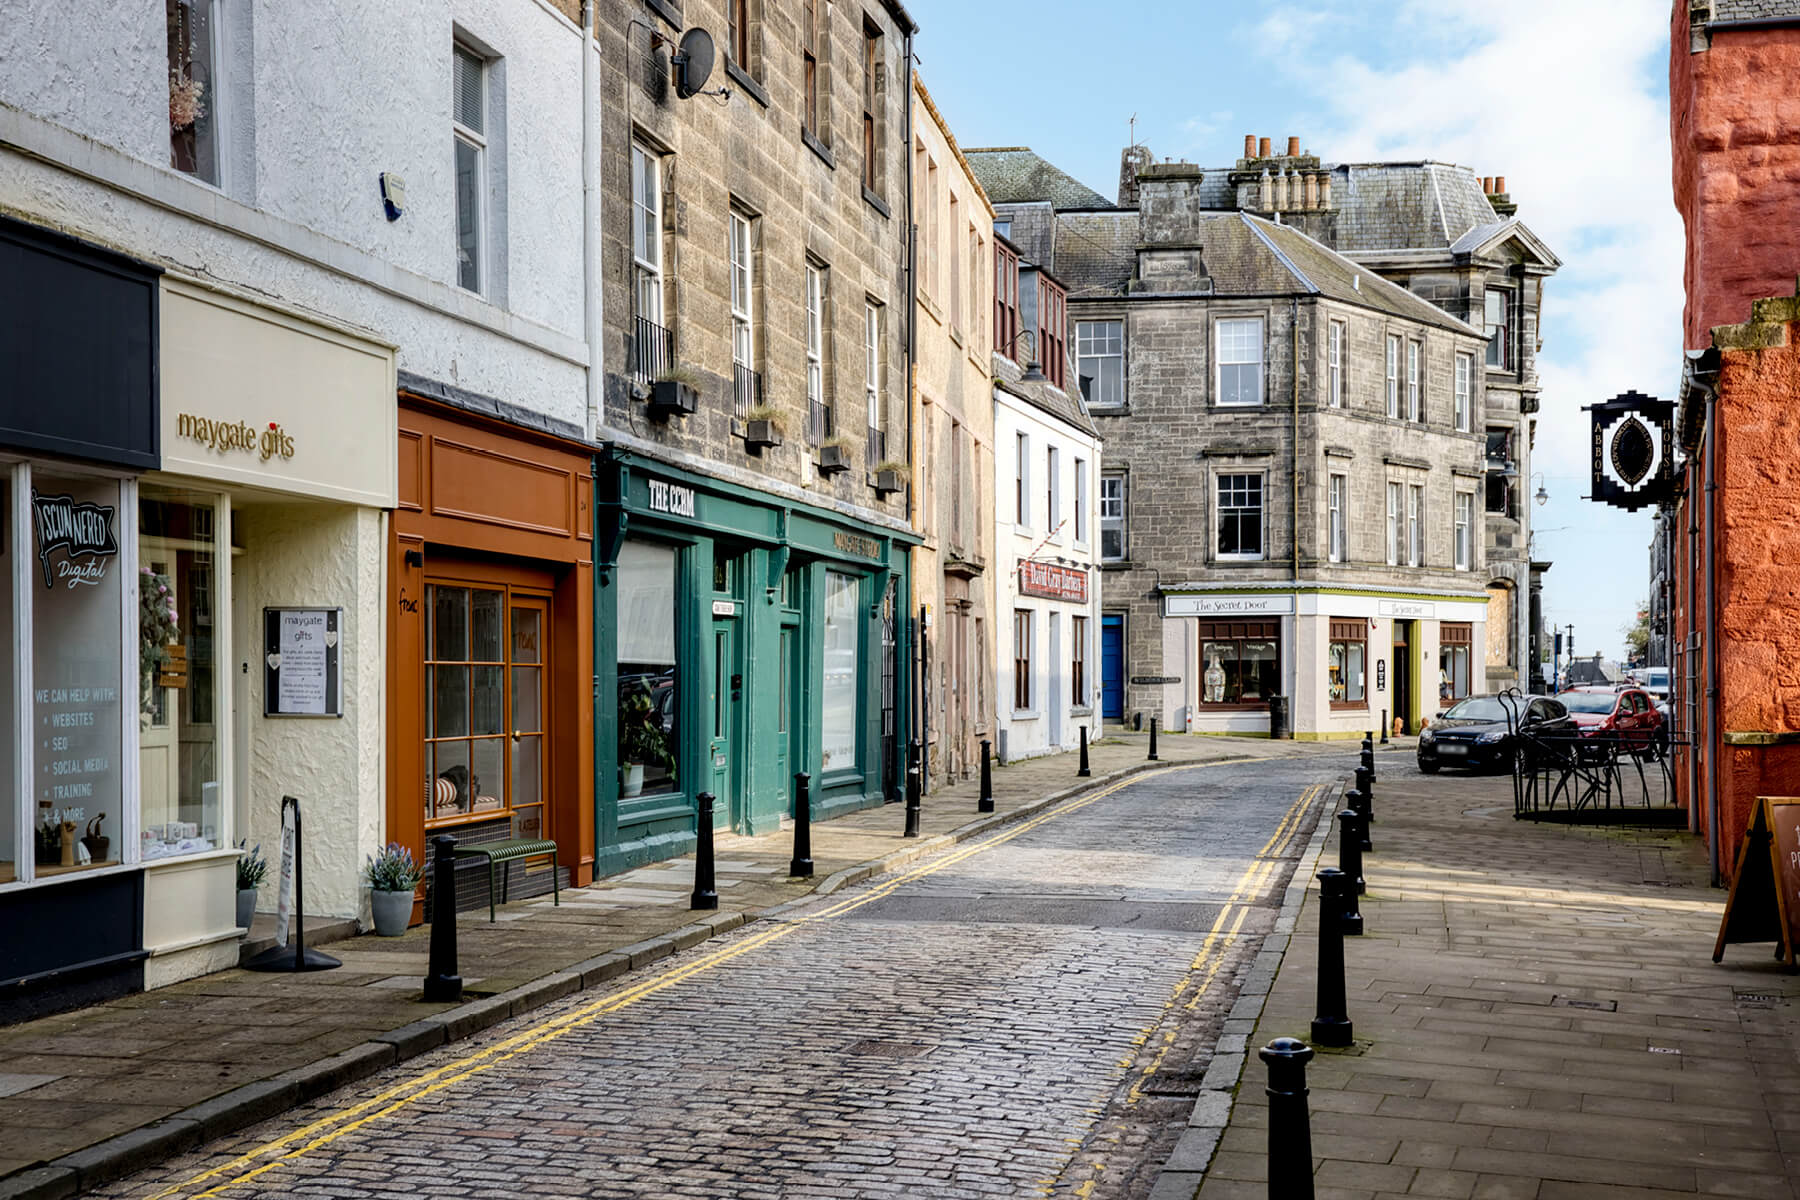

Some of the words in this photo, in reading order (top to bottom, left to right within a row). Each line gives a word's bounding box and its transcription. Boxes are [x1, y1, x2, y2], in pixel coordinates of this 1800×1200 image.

[177, 412, 257, 453] maygate
[260, 422, 295, 461] gifts
[1594, 422, 1602, 482] ABBOT
[1663, 420, 1671, 480] HOUSE
[648, 479, 668, 512] THE
[43, 504, 106, 546] SCUNNERED
[57, 557, 106, 588] Digital
[1193, 600, 1211, 611] The
[1213, 600, 1242, 611] Secret
[1244, 601, 1268, 610] Door
[285, 616, 323, 627] maygate
[294, 630, 313, 641] gifts
[35, 689, 49, 703] WE
[51, 688, 68, 703] CAN
[70, 687, 90, 702] HELP
[52, 712, 94, 728] WEBSITES
[52, 736, 68, 751] SEO
[53, 760, 82, 776] SOCIAL
[84, 758, 109, 773] MEDIA
[54, 783, 93, 799] TRAINING
[63, 807, 85, 823] MORE
